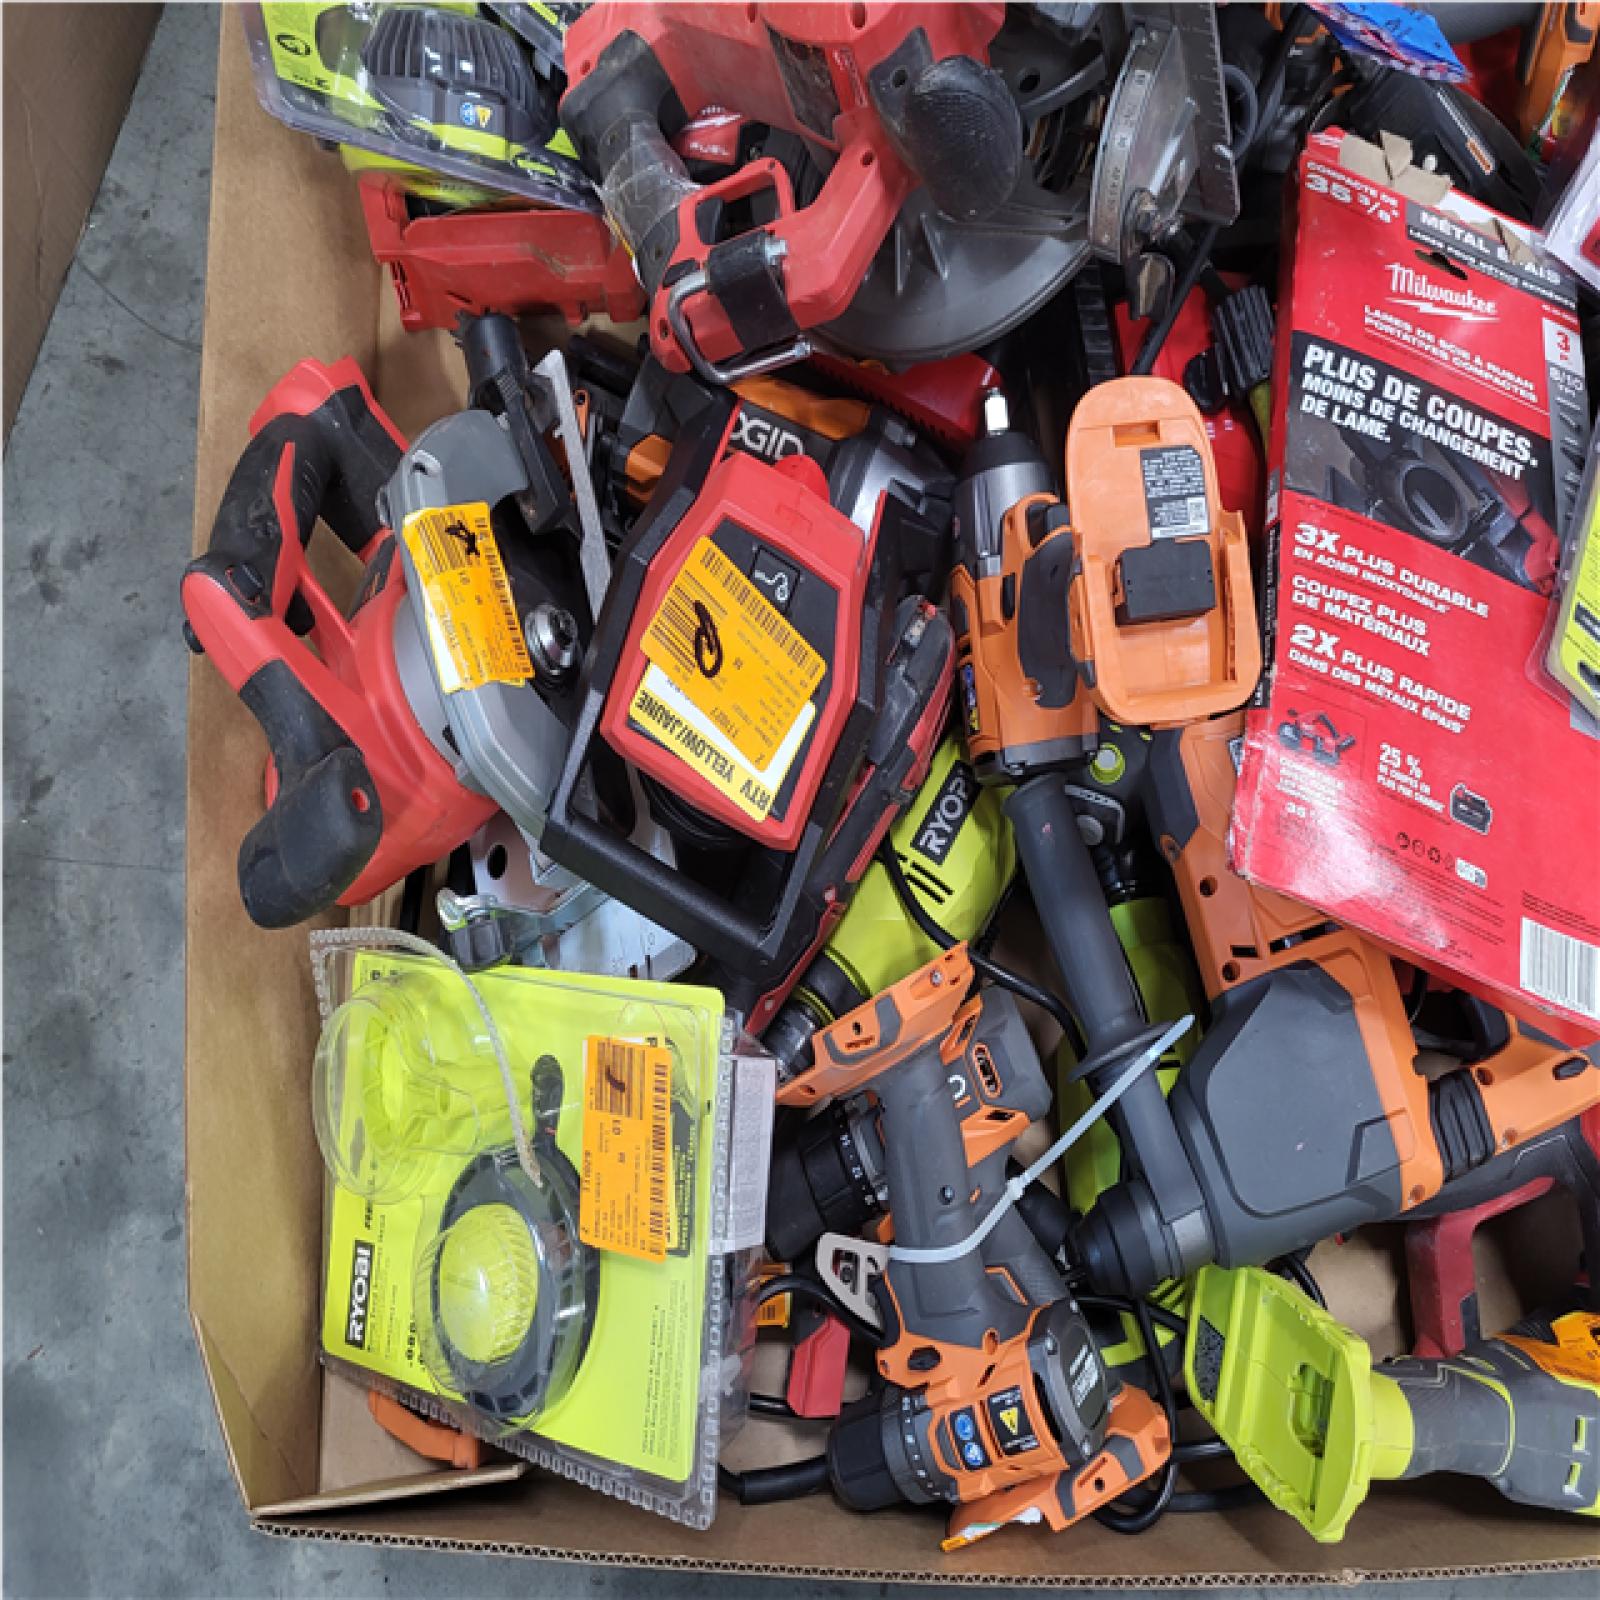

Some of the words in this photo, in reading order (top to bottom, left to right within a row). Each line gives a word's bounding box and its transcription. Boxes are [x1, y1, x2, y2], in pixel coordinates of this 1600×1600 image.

[1385, 262, 1498, 315] Milwaukee
[1300, 393, 1329, 419] DE
[1331, 404, 1391, 444] LAME.
[1302, 372, 1366, 410] MOINS
[1370, 396, 1396, 422] DE
[1400, 410, 1526, 480] CHANGEMENT
[1303, 344, 1376, 391] PLUS
[1383, 374, 1421, 411] DE
[1427, 394, 1539, 469] COUPES.
[1293, 546, 1313, 561] EN
[1315, 554, 1359, 576] ACIER
[1294, 523, 1341, 555] 3X
[1343, 544, 1395, 576] PLUS
[1400, 567, 1489, 619] DURABLE
[1292, 589, 1320, 610] DE
[1292, 574, 1373, 612] COUPEZ
[1377, 603, 1426, 636] PLUS
[1288, 648, 1328, 673] DANS
[1331, 665, 1361, 686] DES
[1290, 624, 1341, 660] 2X
[1341, 649, 1395, 684] PLUS
[1399, 674, 1472, 721] RAPIDE
[634, 689, 736, 783] YELLOW/JAUNE
[1378, 742, 1401, 768] 25
[1406, 753, 1422, 779] %
[739, 779, 771, 811] RTV
[349, 1245, 371, 1343] RYOBI
